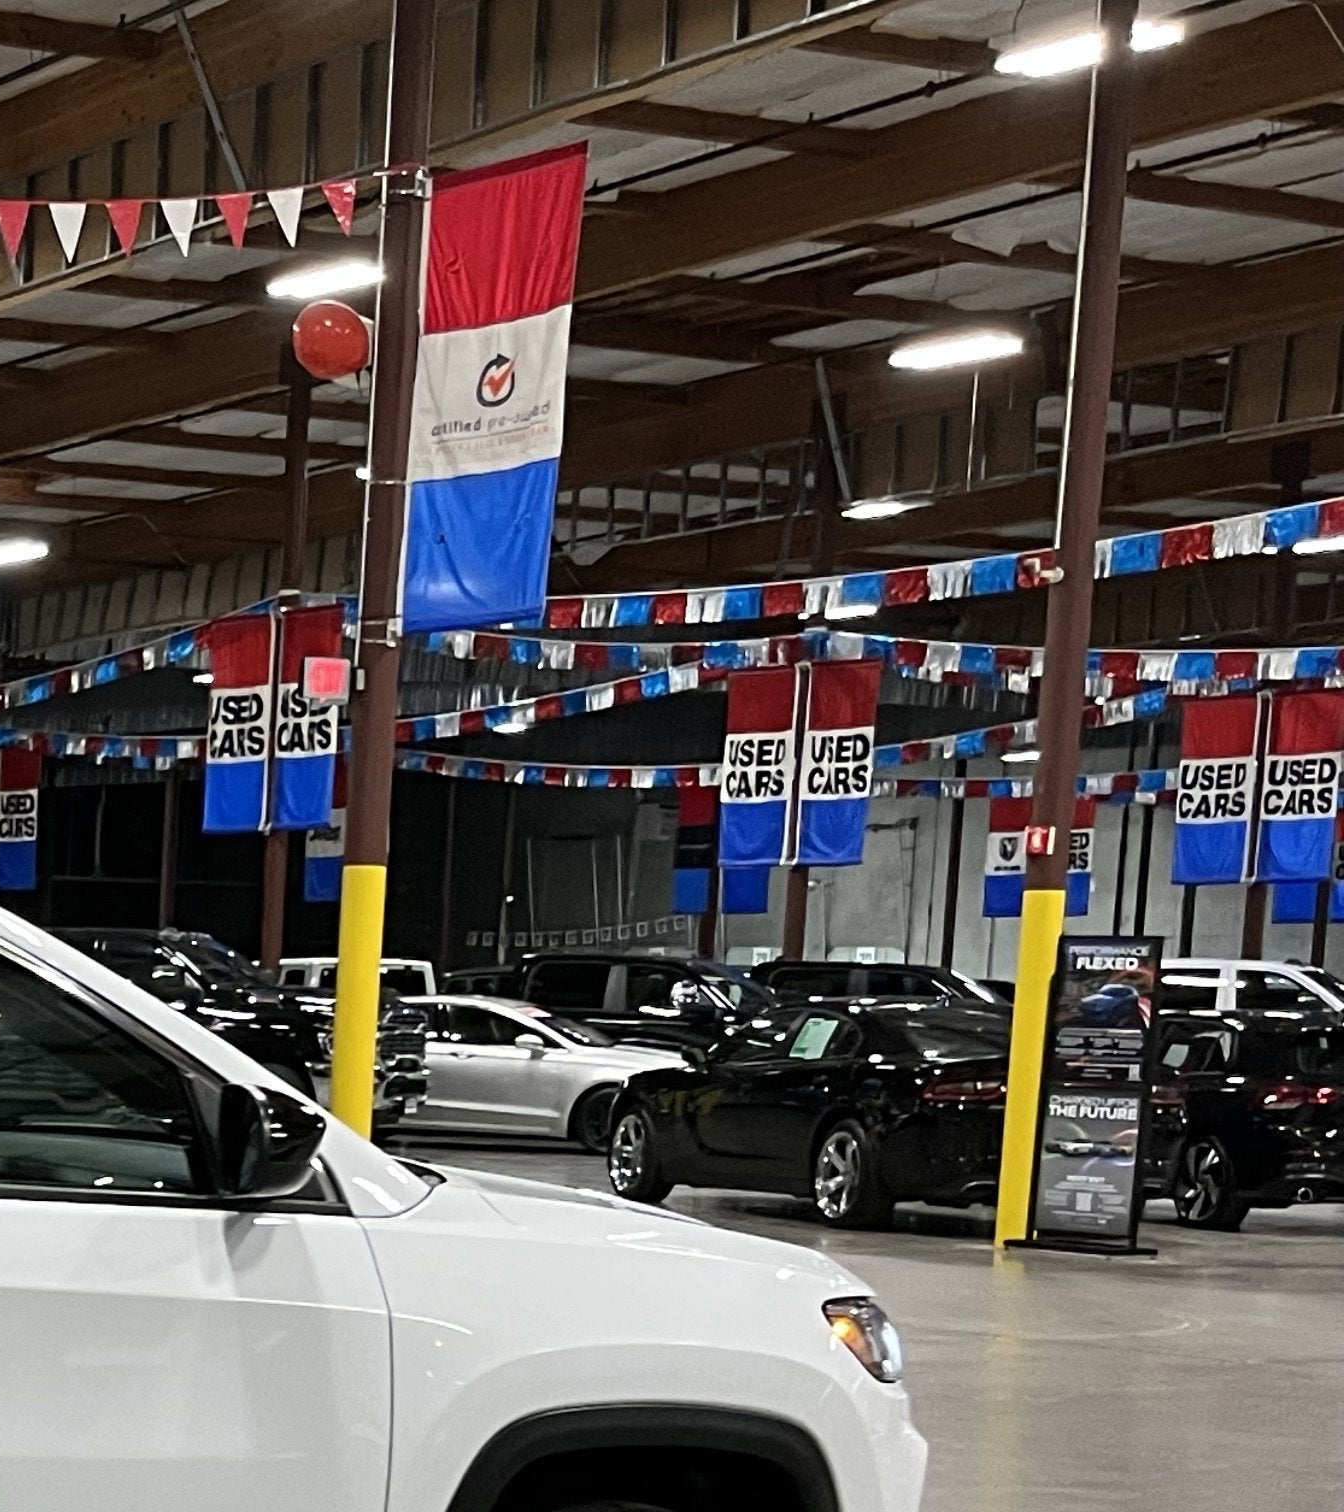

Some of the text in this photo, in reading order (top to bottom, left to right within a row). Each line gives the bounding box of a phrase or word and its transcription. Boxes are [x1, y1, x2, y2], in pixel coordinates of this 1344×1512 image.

[728, 738, 786, 767] USED
[811, 733, 870, 764] USED
[725, 768, 785, 798] CARS
[808, 764, 869, 795] CARS
[1180, 763, 1247, 791] USED
[1268, 758, 1337, 787] USED
[0, 793, 35, 815] USED
[1178, 791, 1246, 819] CARS
[1263, 787, 1333, 816] CARS
[1069, 832, 1090, 850] ED
[1068, 852, 1089, 870] RS
[1076, 956, 1139, 971] FLEXED
[1049, 1104, 1138, 1120] THE FUTURE
